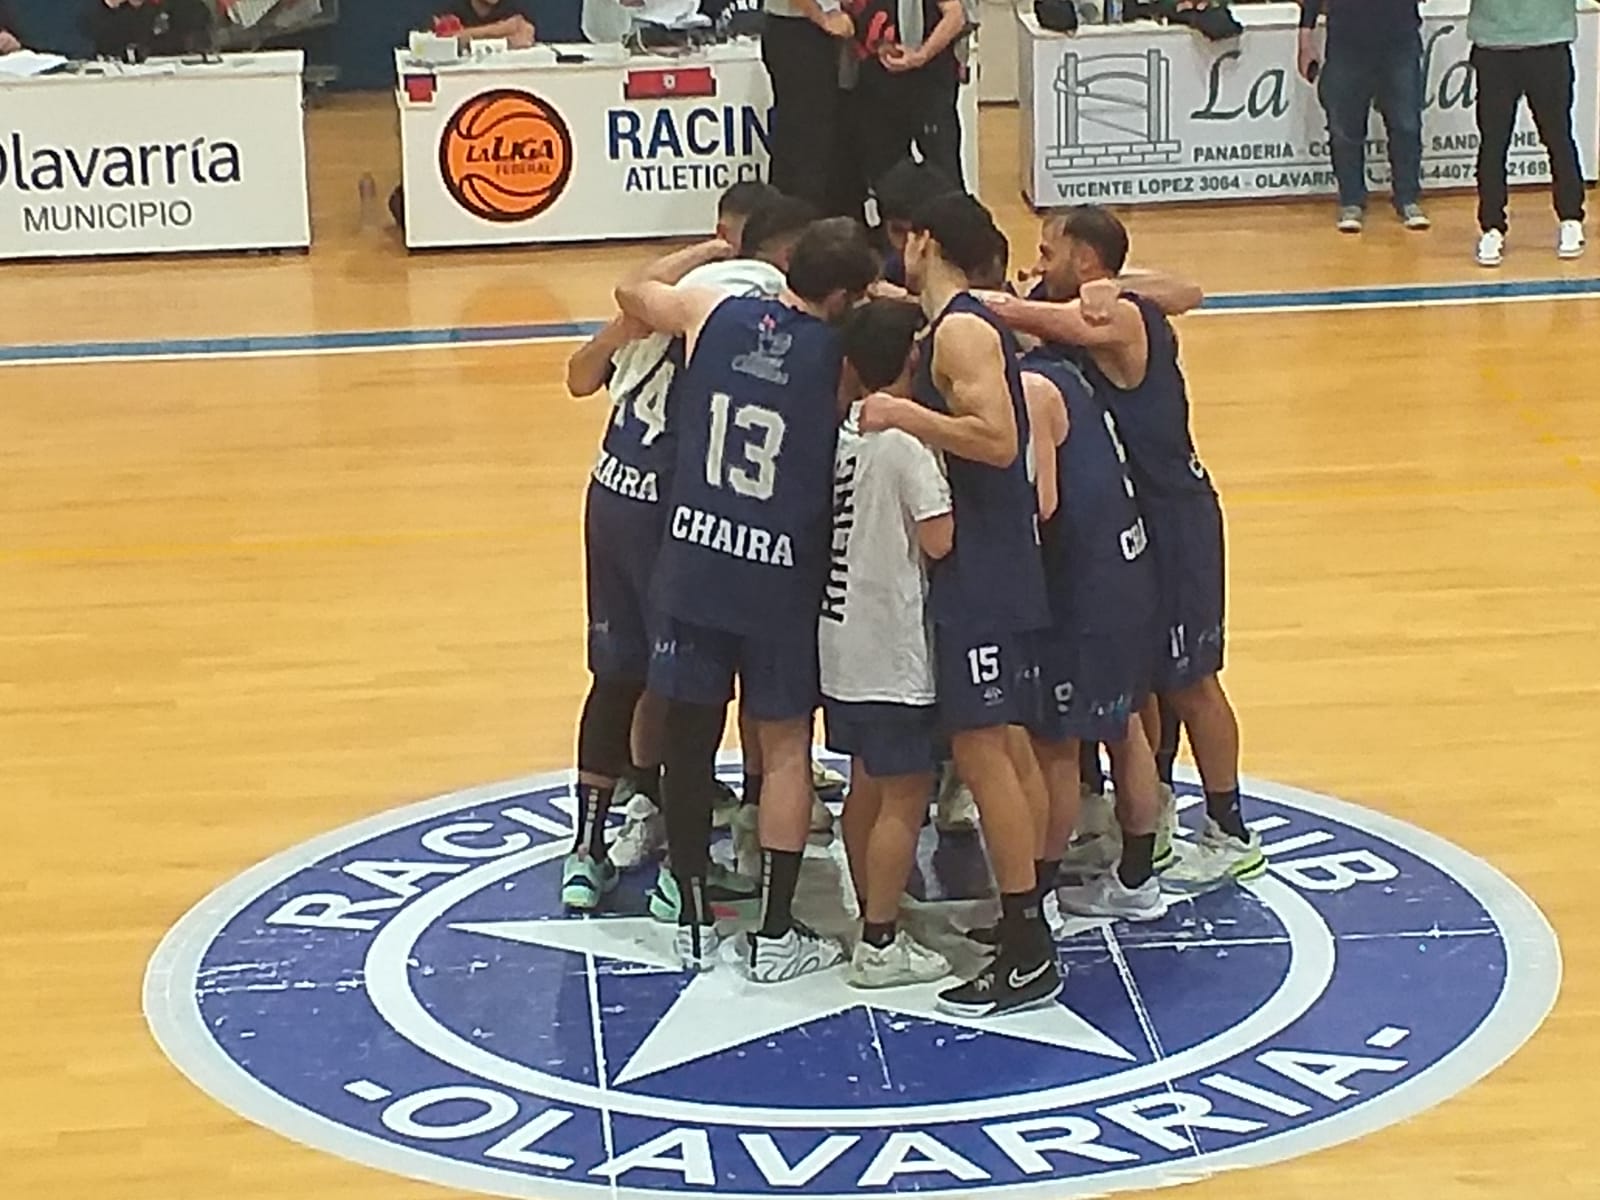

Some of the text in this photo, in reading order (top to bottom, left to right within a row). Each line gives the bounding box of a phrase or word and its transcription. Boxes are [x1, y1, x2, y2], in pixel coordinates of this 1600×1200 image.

[1190, 50, 1290, 120] La
[608, 105, 777, 160] RACIN
[1192, 143, 1295, 163] PANADERIA
[0, 132, 241, 190] lavarría
[625, 164, 730, 191] ATLETIC
[1057, 180, 1133, 198] VICENTE
[1138, 176, 1195, 195] LOPEZ
[1199, 175, 1241, 192] 3064
[1255, 171, 1336, 188] OLAVARR
[23, 200, 192, 232] MUNICIPIO
[705, 392, 786, 501] 13
[671, 504, 795, 567] CHAIRA
[967, 645, 1000, 684] 15
